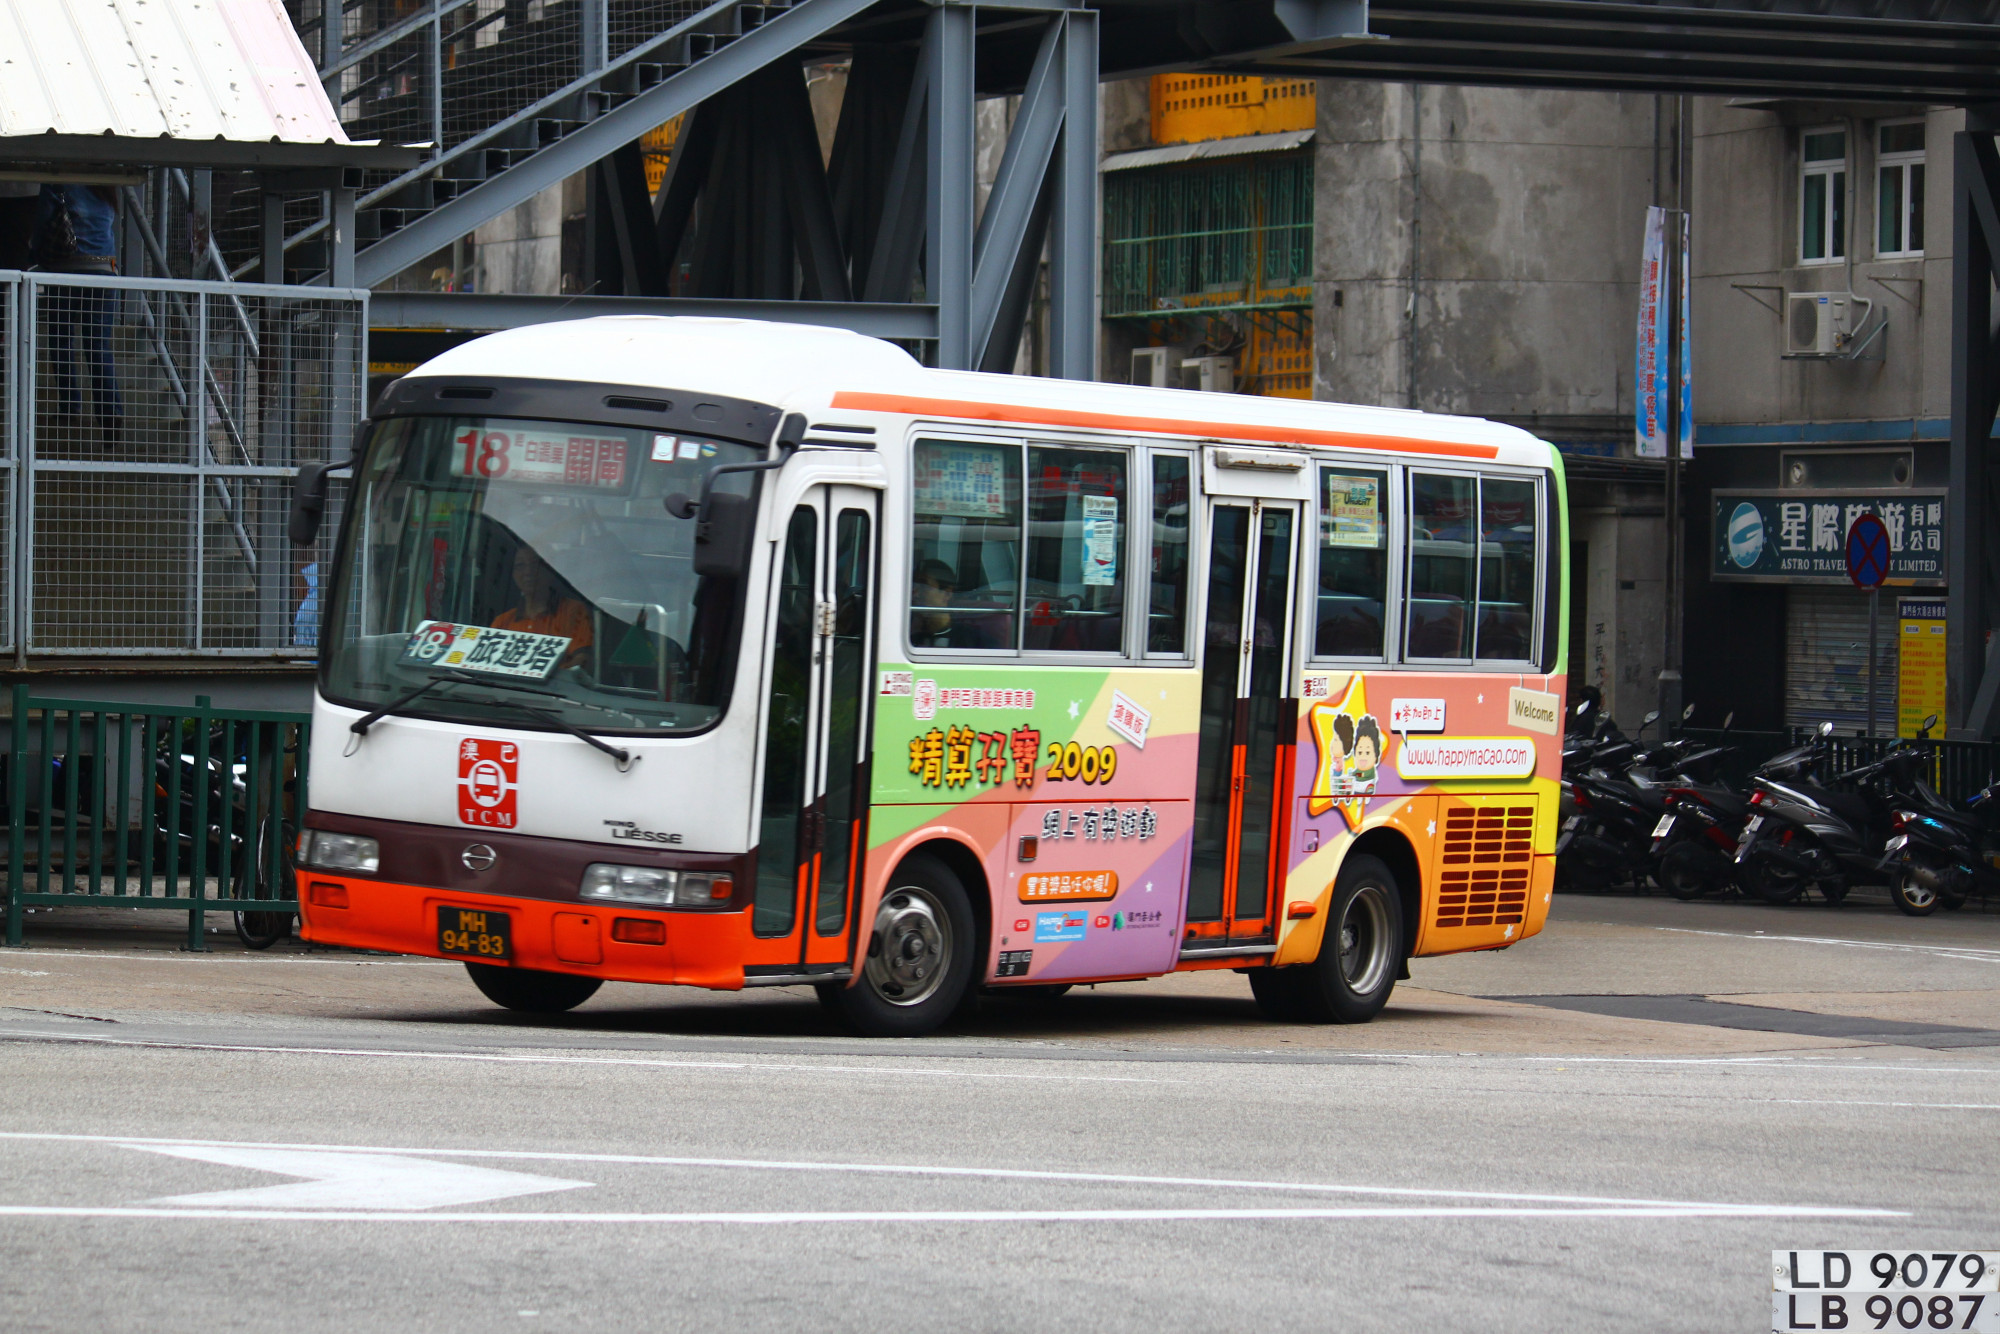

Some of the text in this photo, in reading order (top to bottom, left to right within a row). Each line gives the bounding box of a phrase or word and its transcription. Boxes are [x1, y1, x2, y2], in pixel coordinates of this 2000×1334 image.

[457, 430, 511, 479] 18
[565, 438, 628, 488] 關閘
[1781, 558, 1809, 570] ASTRO
[1814, 559, 1847, 570] TRAVEL
[1899, 560, 1936, 572] LIMITED
[408, 629, 564, 671] 18 旅遊塔
[880, 674, 891, 694] 上
[1313, 678, 1327, 686] EXIT
[1403, 704, 1441, 722] 參加即上
[1515, 699, 1554, 722] Welcome
[461, 740, 517, 763] 澳巴
[909, 724, 1116, 788] 精算孖寶 2009
[1408, 747, 1526, 767] www.happymacao.com
[464, 808, 512, 826] TCM
[603, 819, 635, 828] HINO
[458, 911, 486, 933] MH
[443, 930, 504, 955] 94-83
